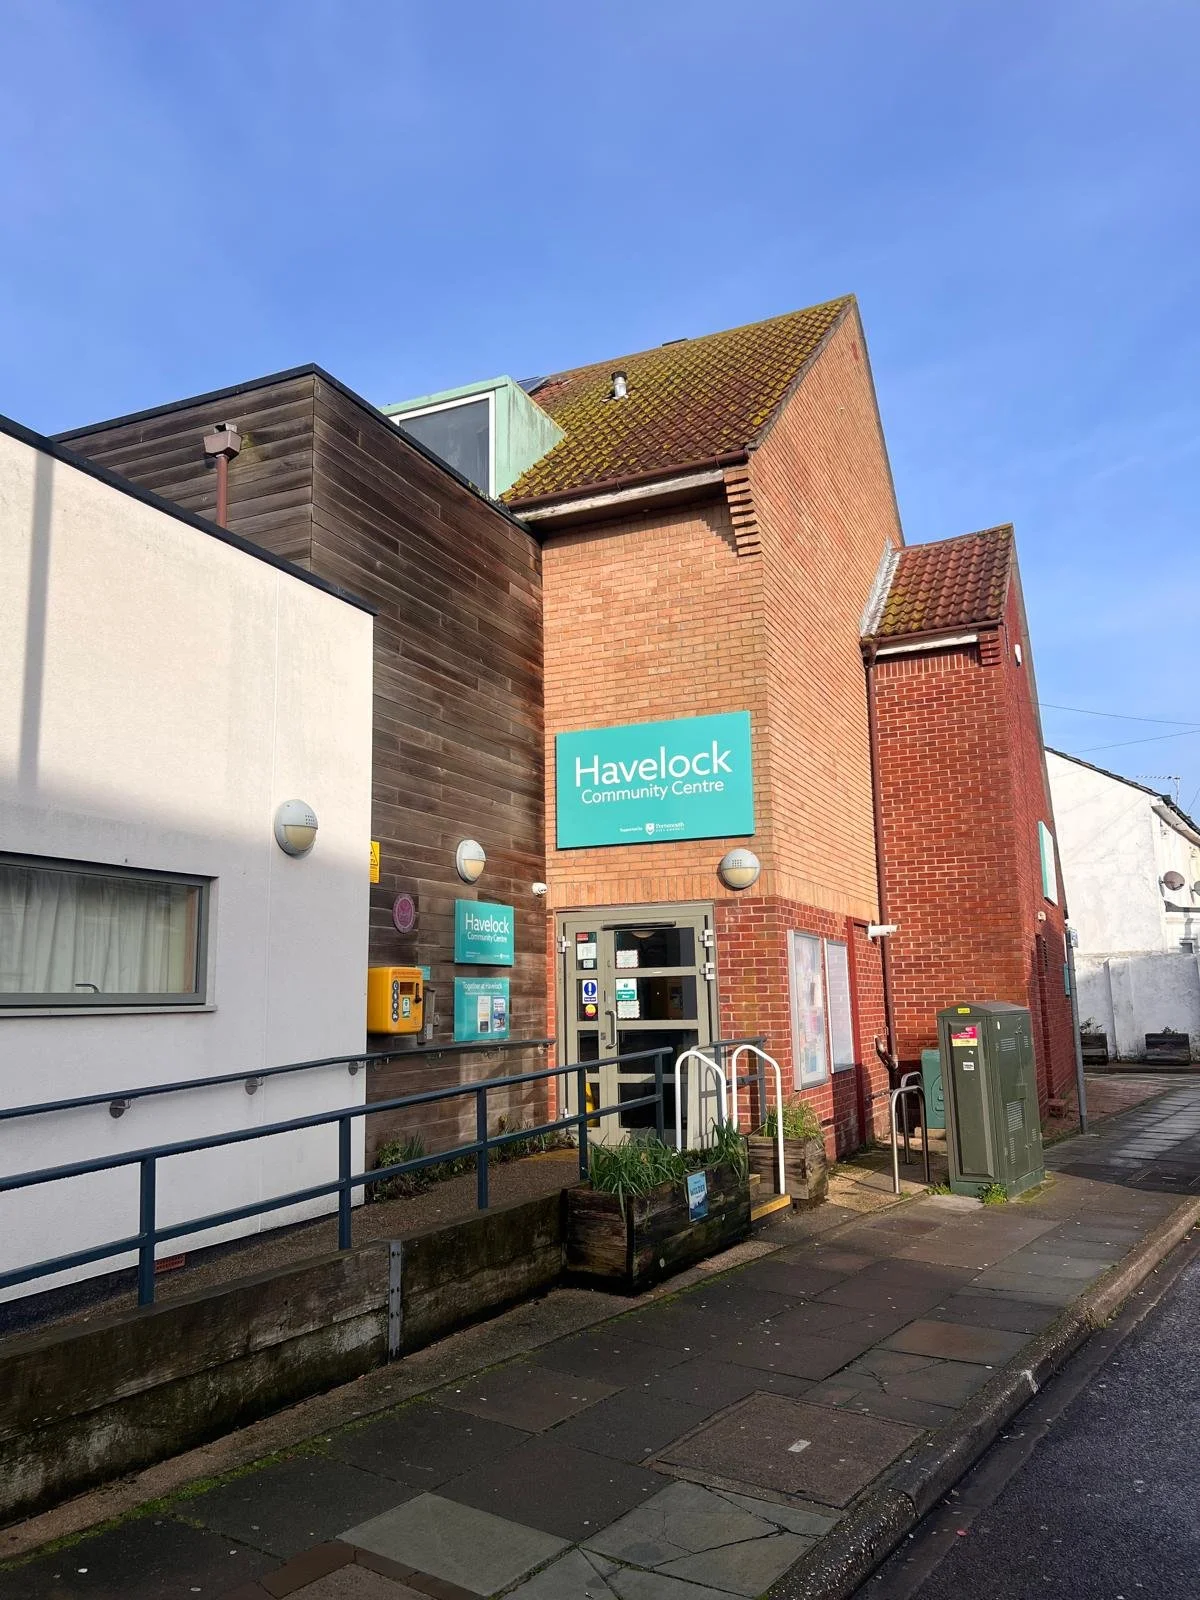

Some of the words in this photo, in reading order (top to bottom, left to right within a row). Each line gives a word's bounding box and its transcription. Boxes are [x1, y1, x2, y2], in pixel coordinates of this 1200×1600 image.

[575, 740, 733, 787] Havelock
[581, 782, 668, 804] Community
[671, 780, 725, 796] Centre
[465, 912, 509, 934] Havelock
[467, 931, 493, 943] Community
